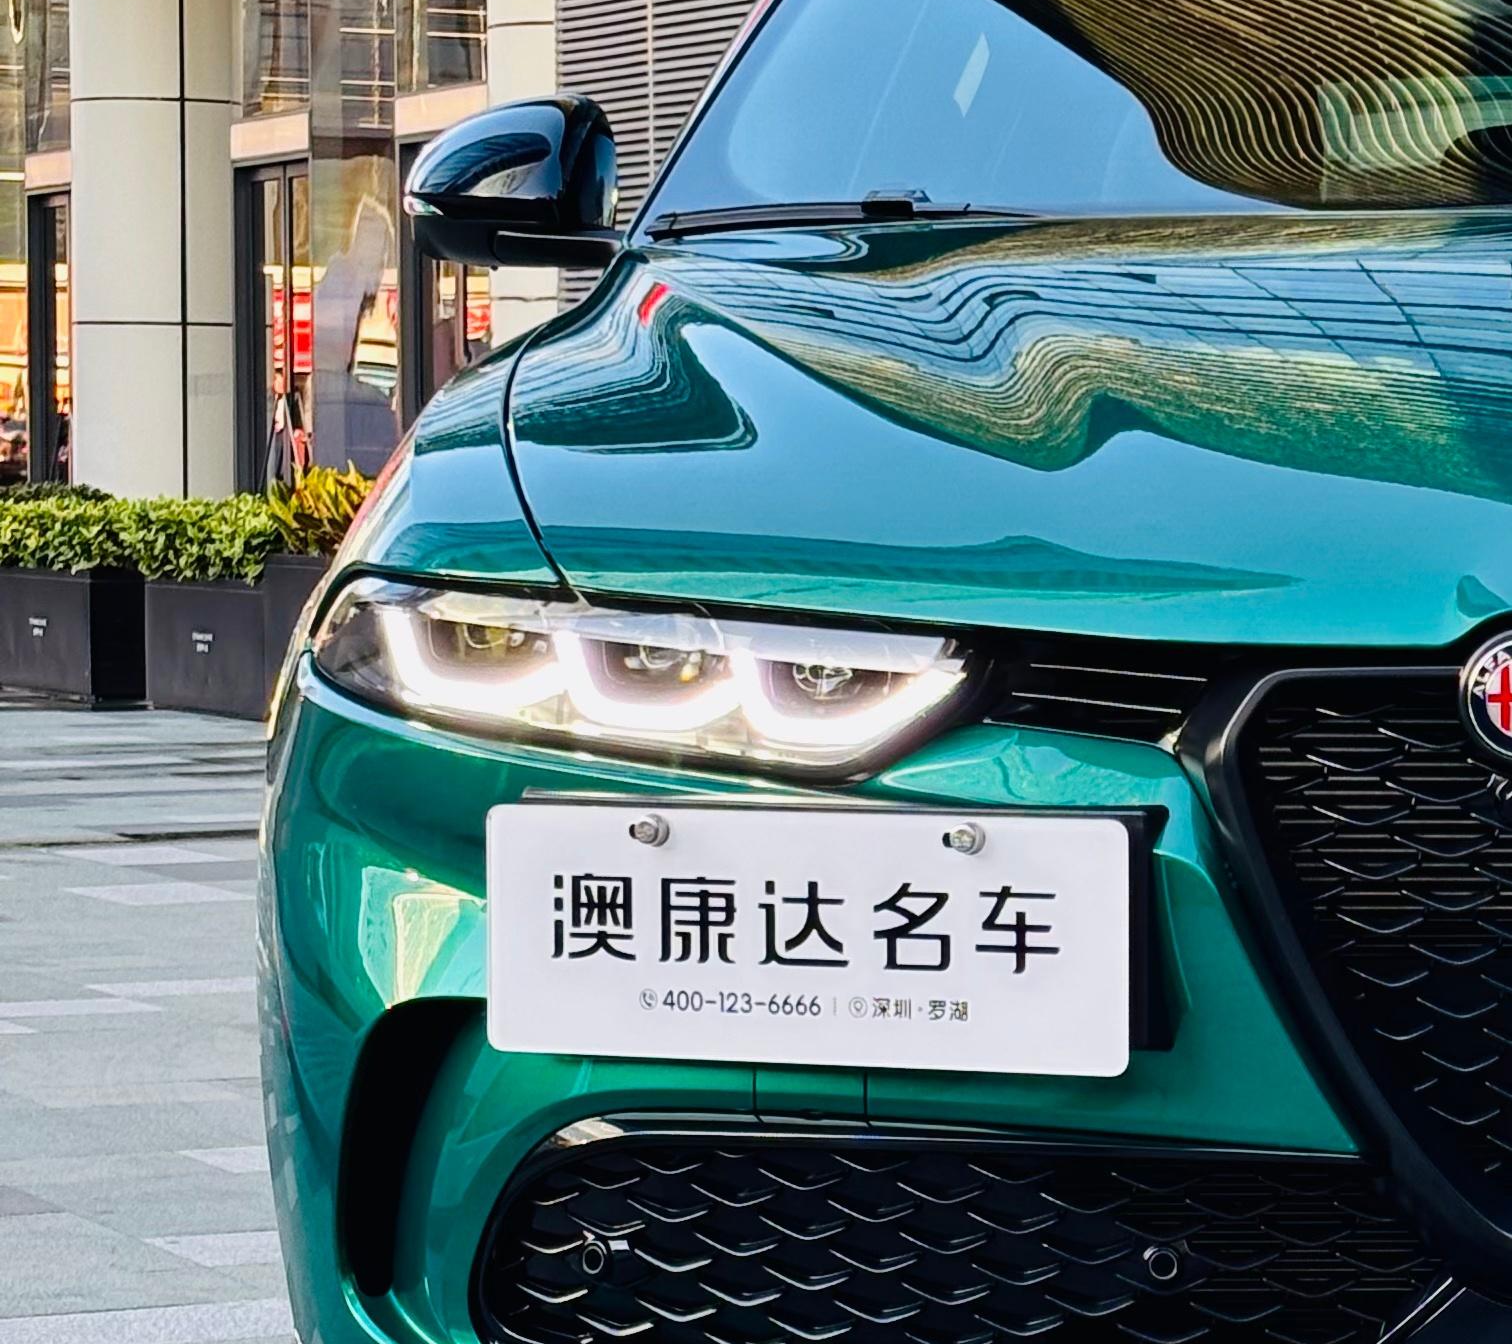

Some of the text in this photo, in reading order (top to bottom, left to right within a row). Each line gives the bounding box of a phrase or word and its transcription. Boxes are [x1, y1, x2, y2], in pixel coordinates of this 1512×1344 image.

[1472, 651, 1512, 699] ALFA
[551, 872, 1061, 975] 澳康达名车
[662, 989, 822, 1017] 400-123-6666
